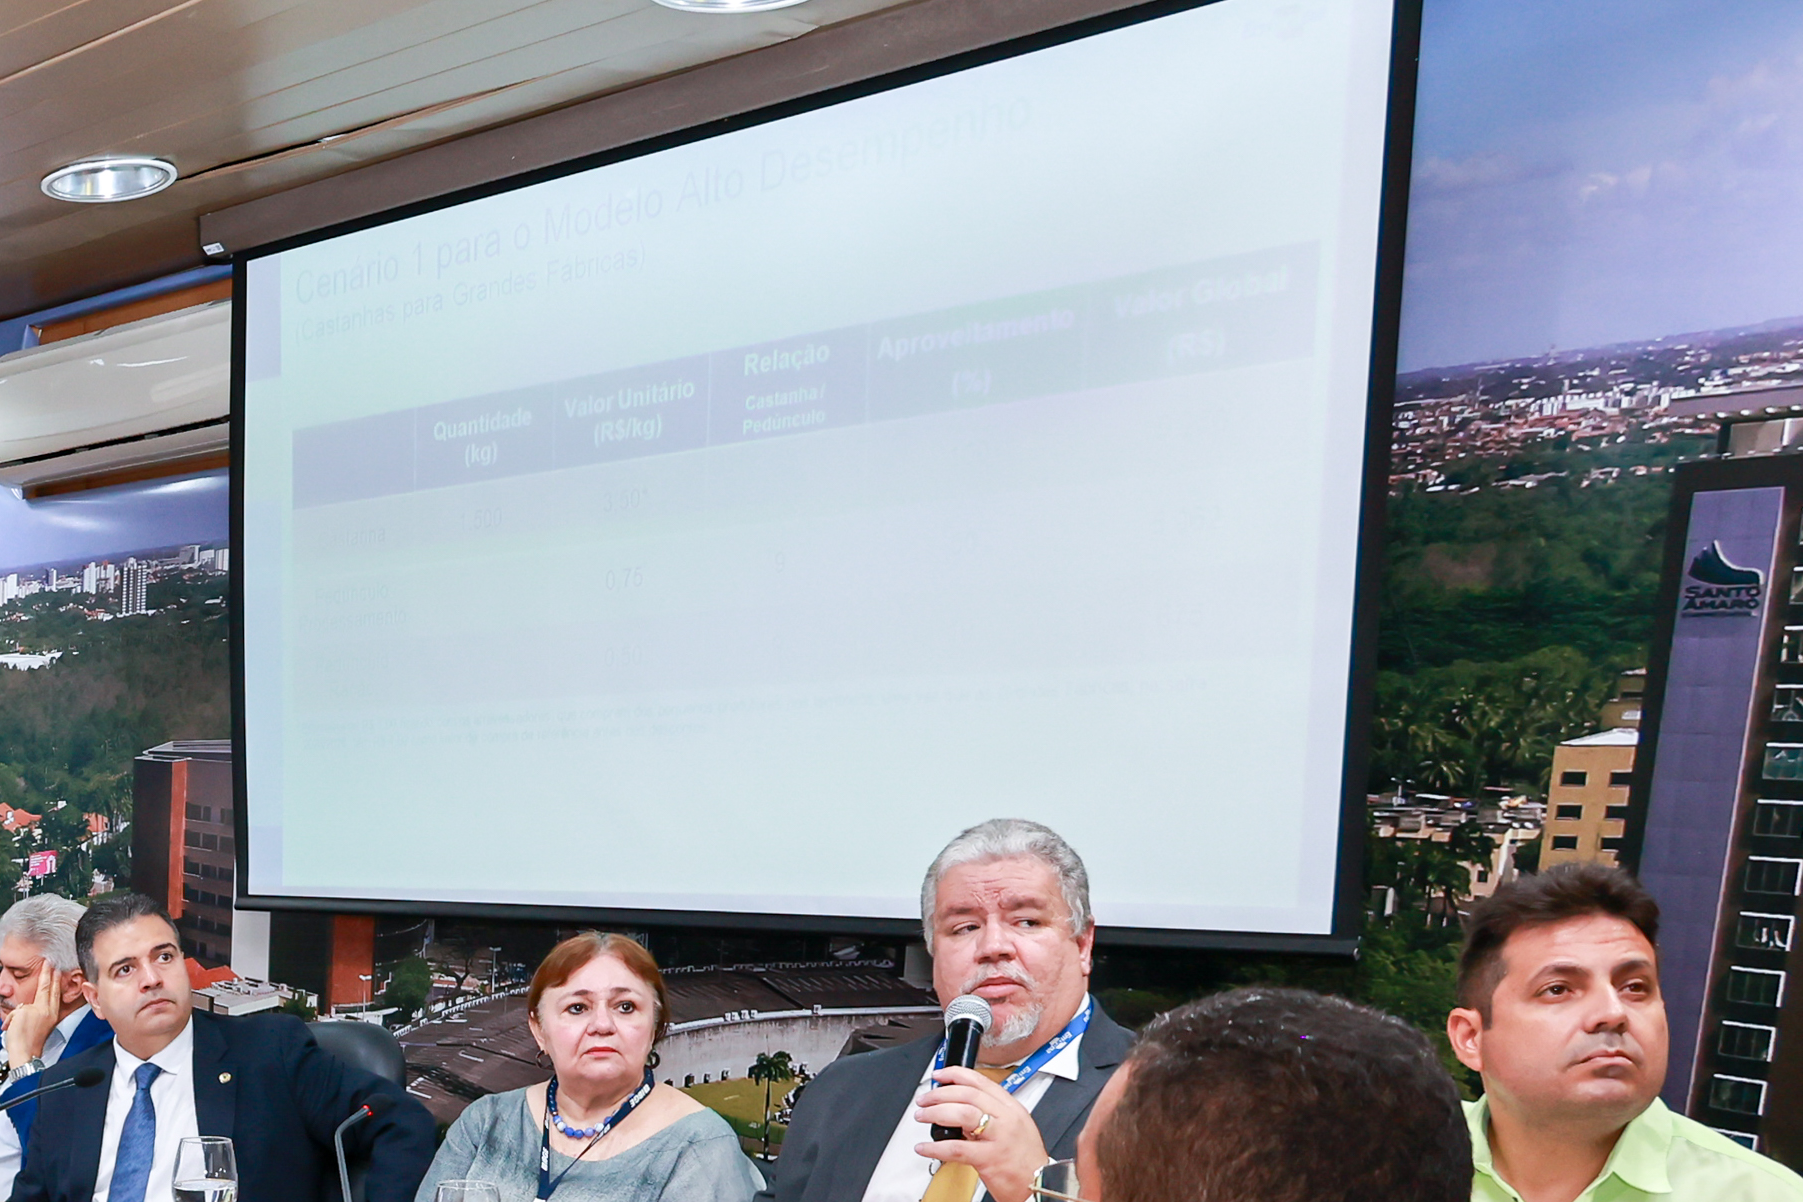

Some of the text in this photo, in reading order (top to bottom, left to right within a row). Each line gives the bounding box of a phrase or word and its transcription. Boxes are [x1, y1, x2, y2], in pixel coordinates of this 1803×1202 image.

[744, 343, 830, 377] Relação
[563, 378, 695, 419] Valor Unitário
[432, 406, 534, 442] Quantidade
[463, 441, 497, 468] (kg)
[1683, 599, 1759, 611] AMARO
[1684, 586, 1760, 600] SANTO
